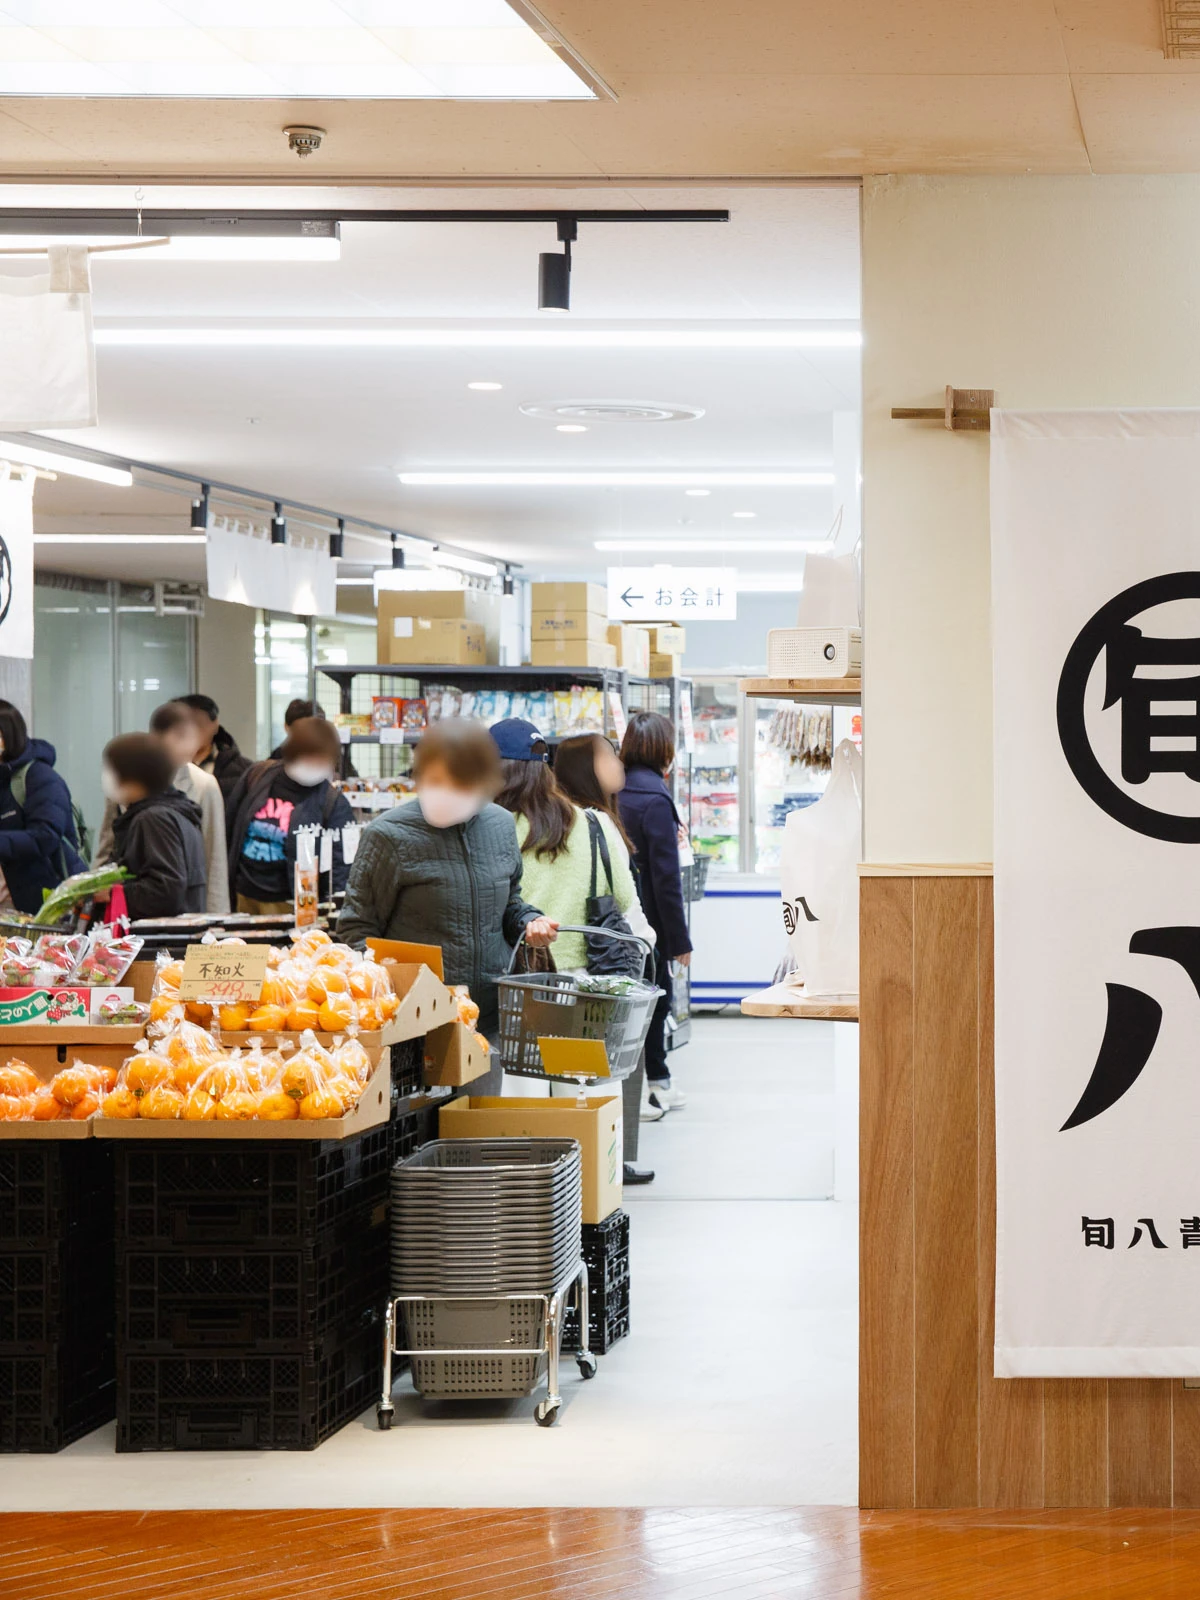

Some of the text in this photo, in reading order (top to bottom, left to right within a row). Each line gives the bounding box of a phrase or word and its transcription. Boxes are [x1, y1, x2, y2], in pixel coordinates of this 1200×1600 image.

[655, 587, 724, 606] お会計
[199, 962, 245, 978] 不知火
